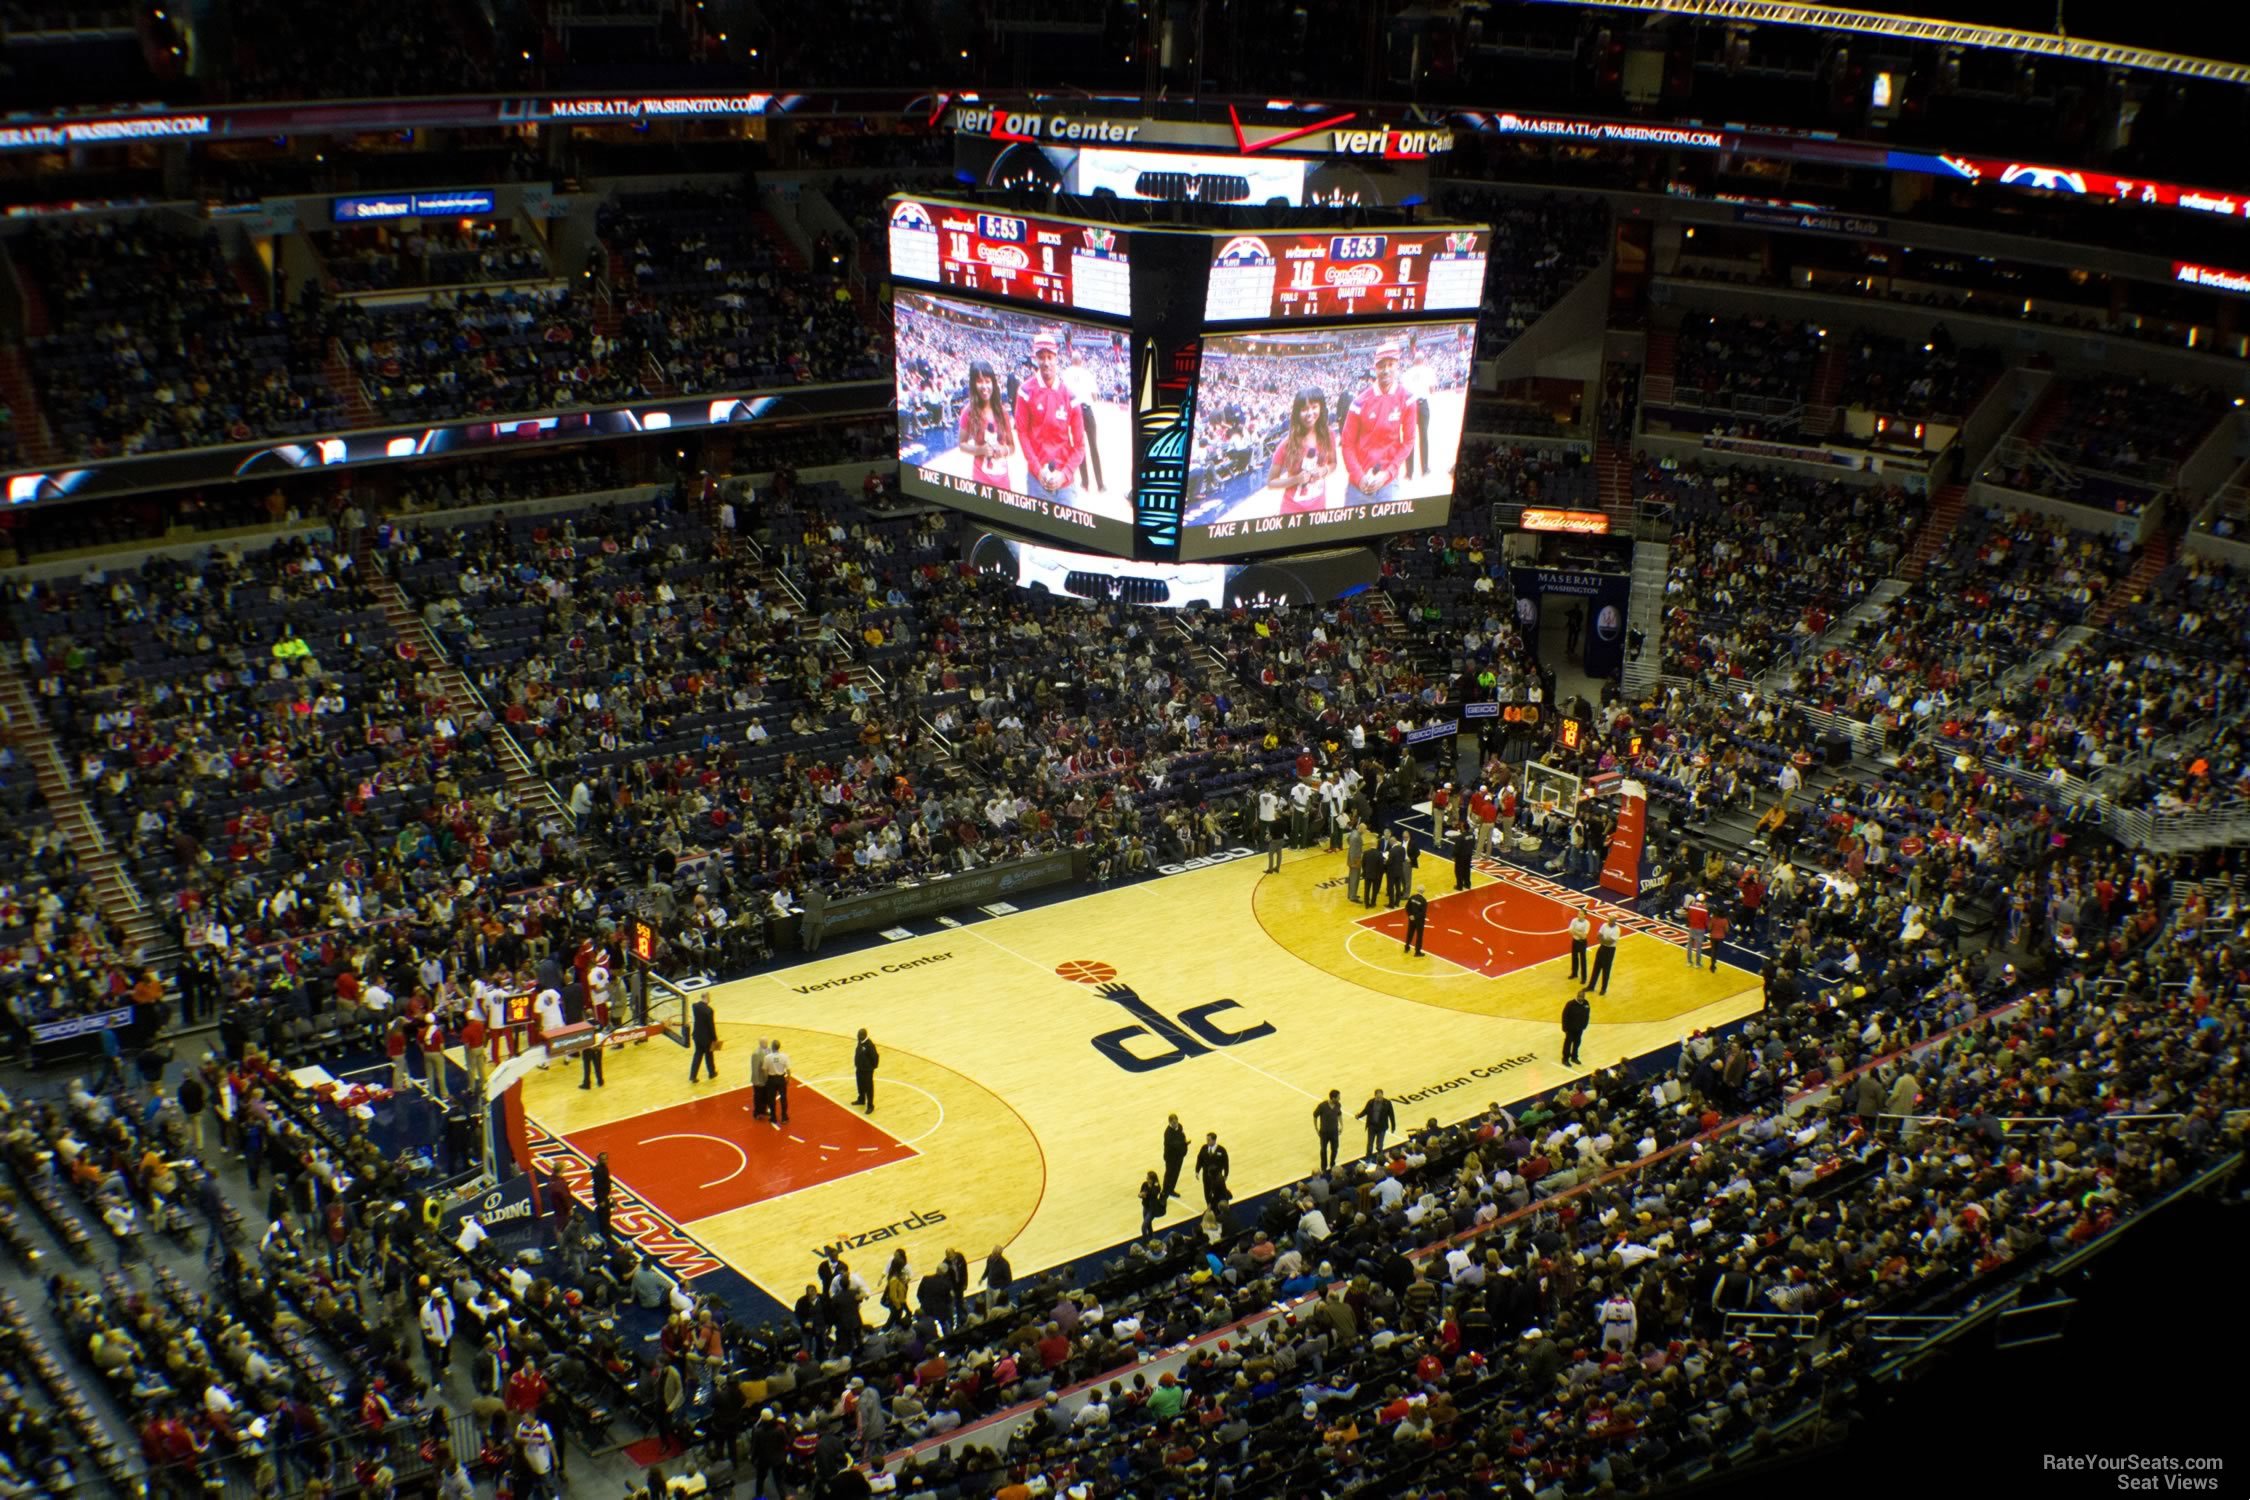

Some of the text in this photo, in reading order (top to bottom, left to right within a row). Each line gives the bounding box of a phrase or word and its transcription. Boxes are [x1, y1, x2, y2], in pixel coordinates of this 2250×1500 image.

[552, 101, 629, 116] MASERATI
[629, 100, 642, 117] of
[956, 104, 1139, 143] verizon Center
[1515, 119, 1721, 148] MASERATI of WASHINGTON.COM
[1333, 124, 1426, 160] verizon
[986, 216, 1019, 241] 5:53
[1042, 247, 1054, 273] 9
[1340, 238, 1376, 258] 5:53
[1397, 244, 1422, 256] BUCKS
[1291, 260, 1316, 290] 16
[1398, 257, 1412, 284] 9
[1347, 298, 1354, 315] 1
[918, 468, 1096, 528] TAKE A LOOK AT TONIGHT'S CAPITOL
[1208, 500, 1414, 539] TAKE A LOOK AT TONIGHT'S CAPITOL
[1521, 511, 1609, 531] Budweiser
[1538, 573, 1604, 587] MASERATI
[1547, 584, 1600, 595] WASHINGTON
[1467, 704, 1498, 714] GEICO
[1156, 847, 1255, 875] GEICO
[791, 951, 954, 996] Verizon Center
[1390, 1052, 1539, 1106] Verizon Center
[811, 1209, 947, 1259] wizards
